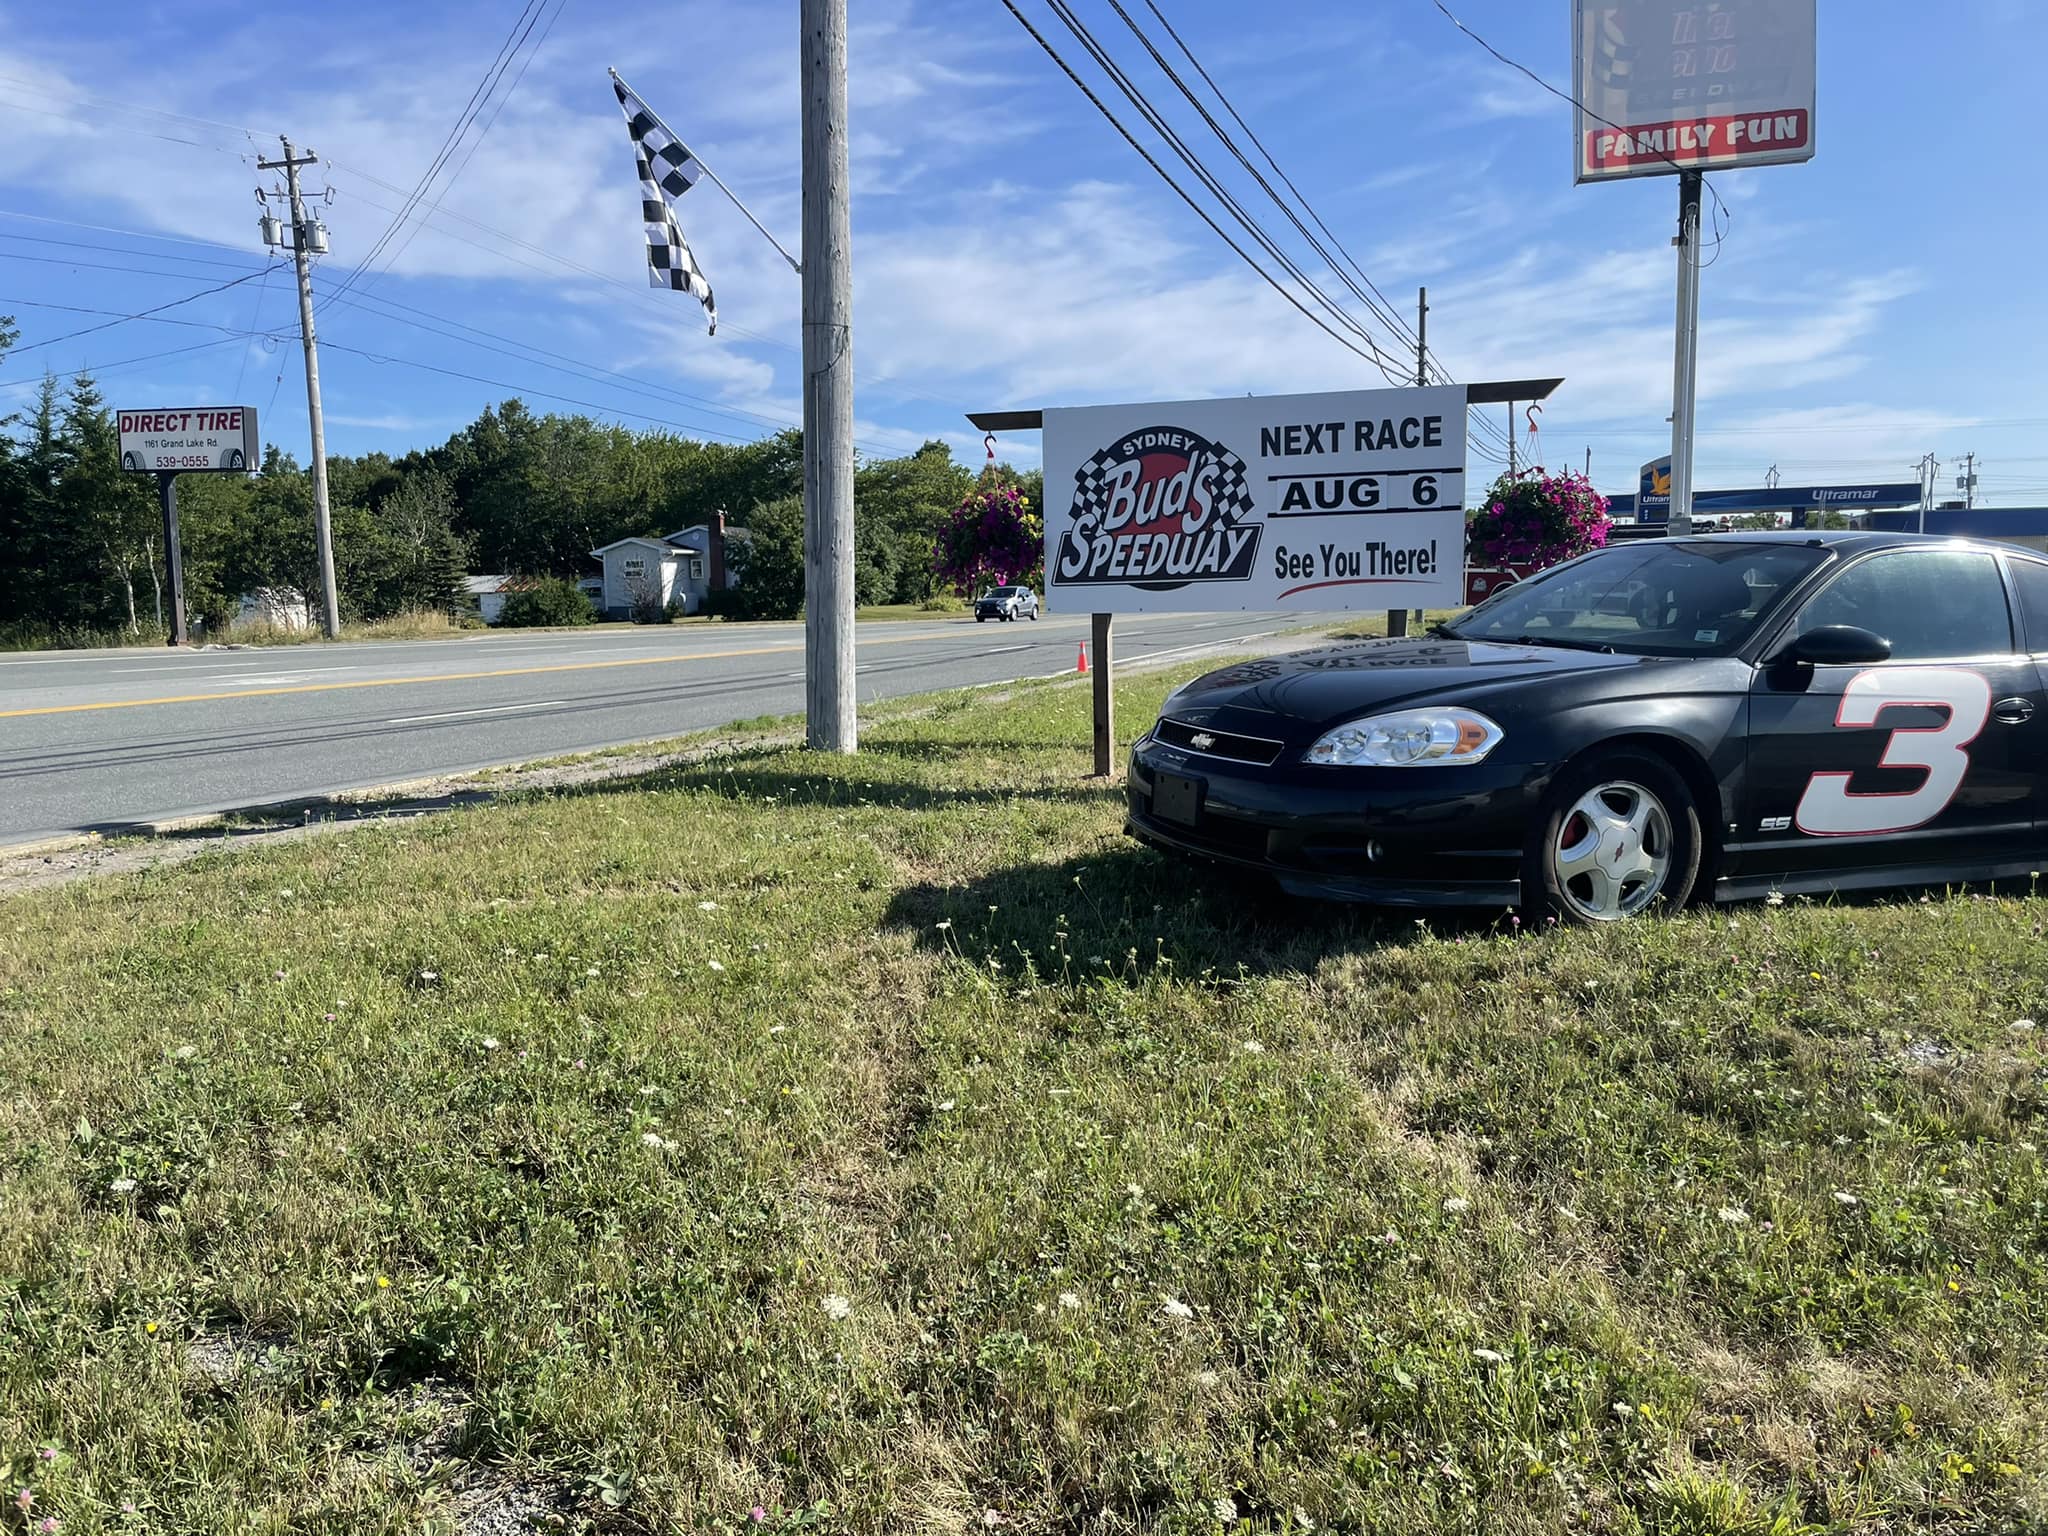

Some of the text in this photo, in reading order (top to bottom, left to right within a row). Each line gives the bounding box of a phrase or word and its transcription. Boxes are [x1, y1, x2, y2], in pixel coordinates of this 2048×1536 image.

[1596, 115, 1798, 159] FAMILY FUN
[121, 412, 242, 433] DIRECT TIRE
[1260, 415, 1443, 457] NEXT RACE
[144, 440, 159, 449] 1161
[161, 439, 184, 448] Grand
[186, 439, 204, 448] Lake
[1123, 433, 1196, 456] SYDNEY
[156, 456, 209, 468] 539-0555
[1280, 475, 1439, 511] AUG 6
[1812, 489, 1879, 501] Ultramar
[1061, 513, 1254, 578] SPEEDWAY
[1275, 540, 1437, 579] See You There!
[1795, 667, 1992, 836] 3
[1758, 816, 1792, 831] SS
